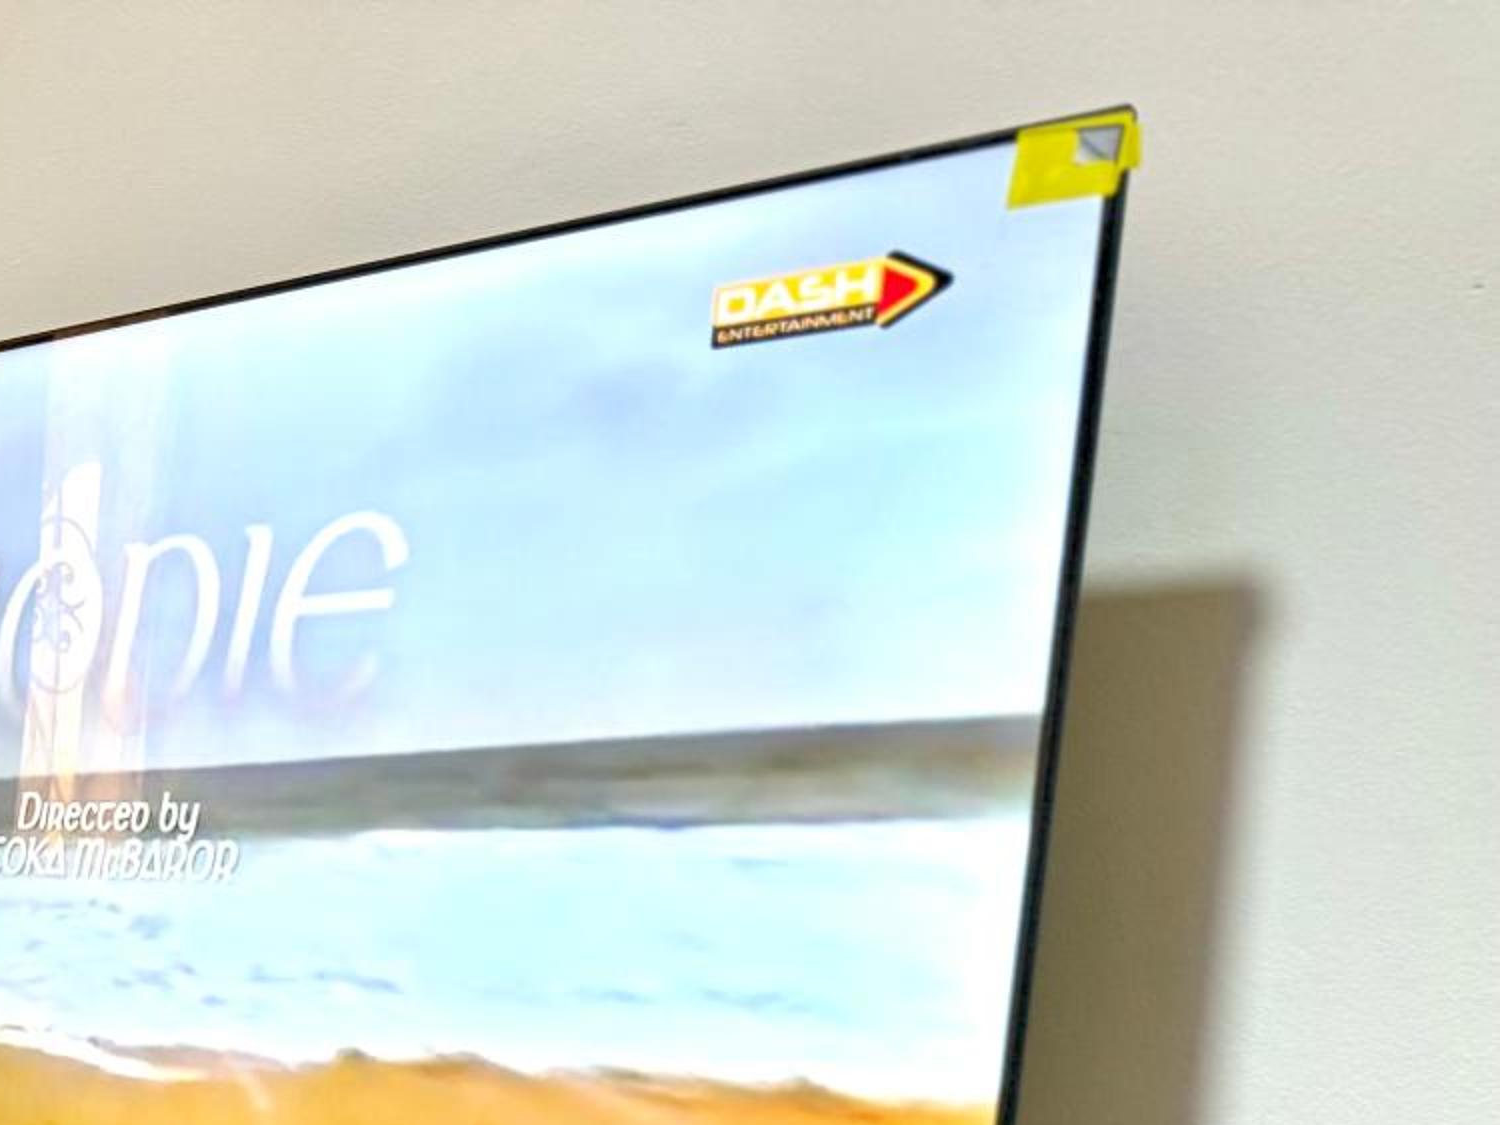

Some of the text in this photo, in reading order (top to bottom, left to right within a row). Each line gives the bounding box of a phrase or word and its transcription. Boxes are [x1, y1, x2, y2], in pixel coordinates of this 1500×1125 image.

[716, 265, 877, 326] DASH
[716, 307, 877, 343] ENTERTAINMENT
[159, 791, 200, 843] by
